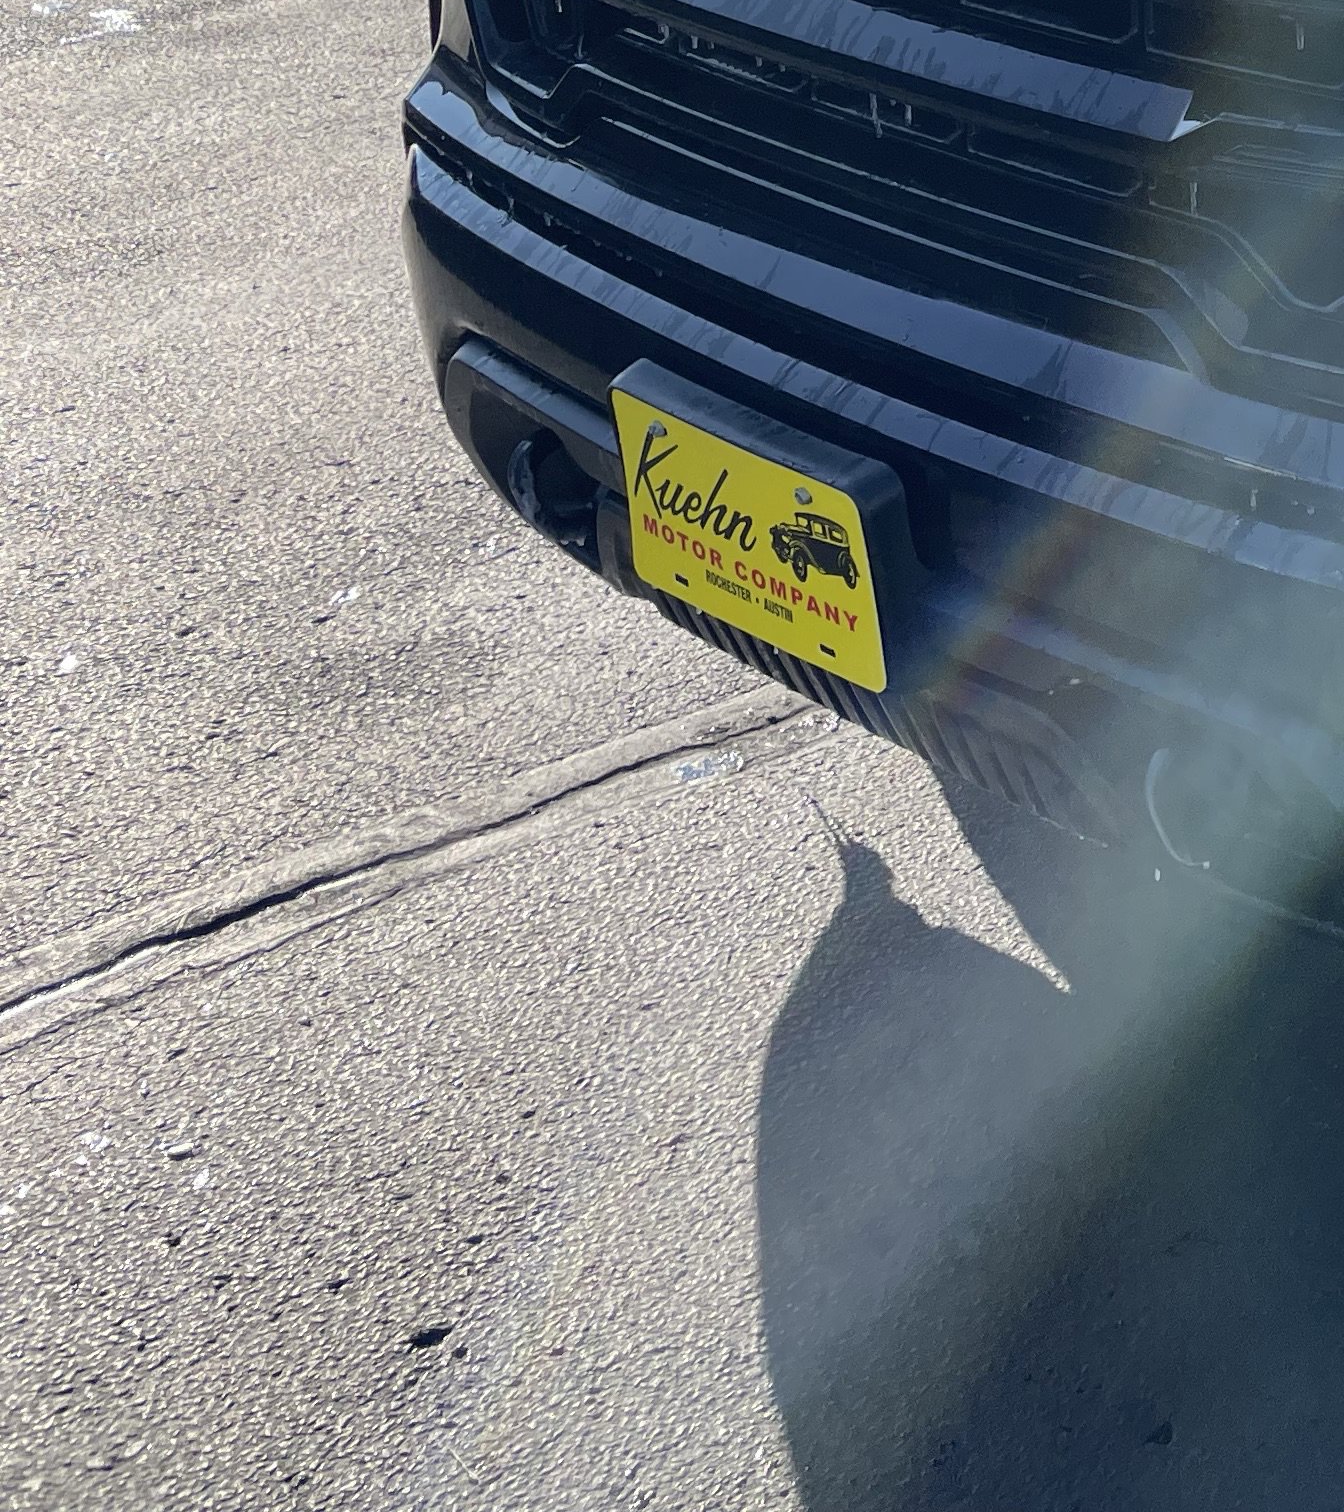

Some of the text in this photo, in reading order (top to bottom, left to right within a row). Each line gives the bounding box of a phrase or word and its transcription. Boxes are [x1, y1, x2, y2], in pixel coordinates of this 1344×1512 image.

[634, 429, 758, 552] Kuehn
[642, 514, 859, 633] MOTOR COMPANY
[705, 569, 794, 624] ROCHESTER AUSTIN
